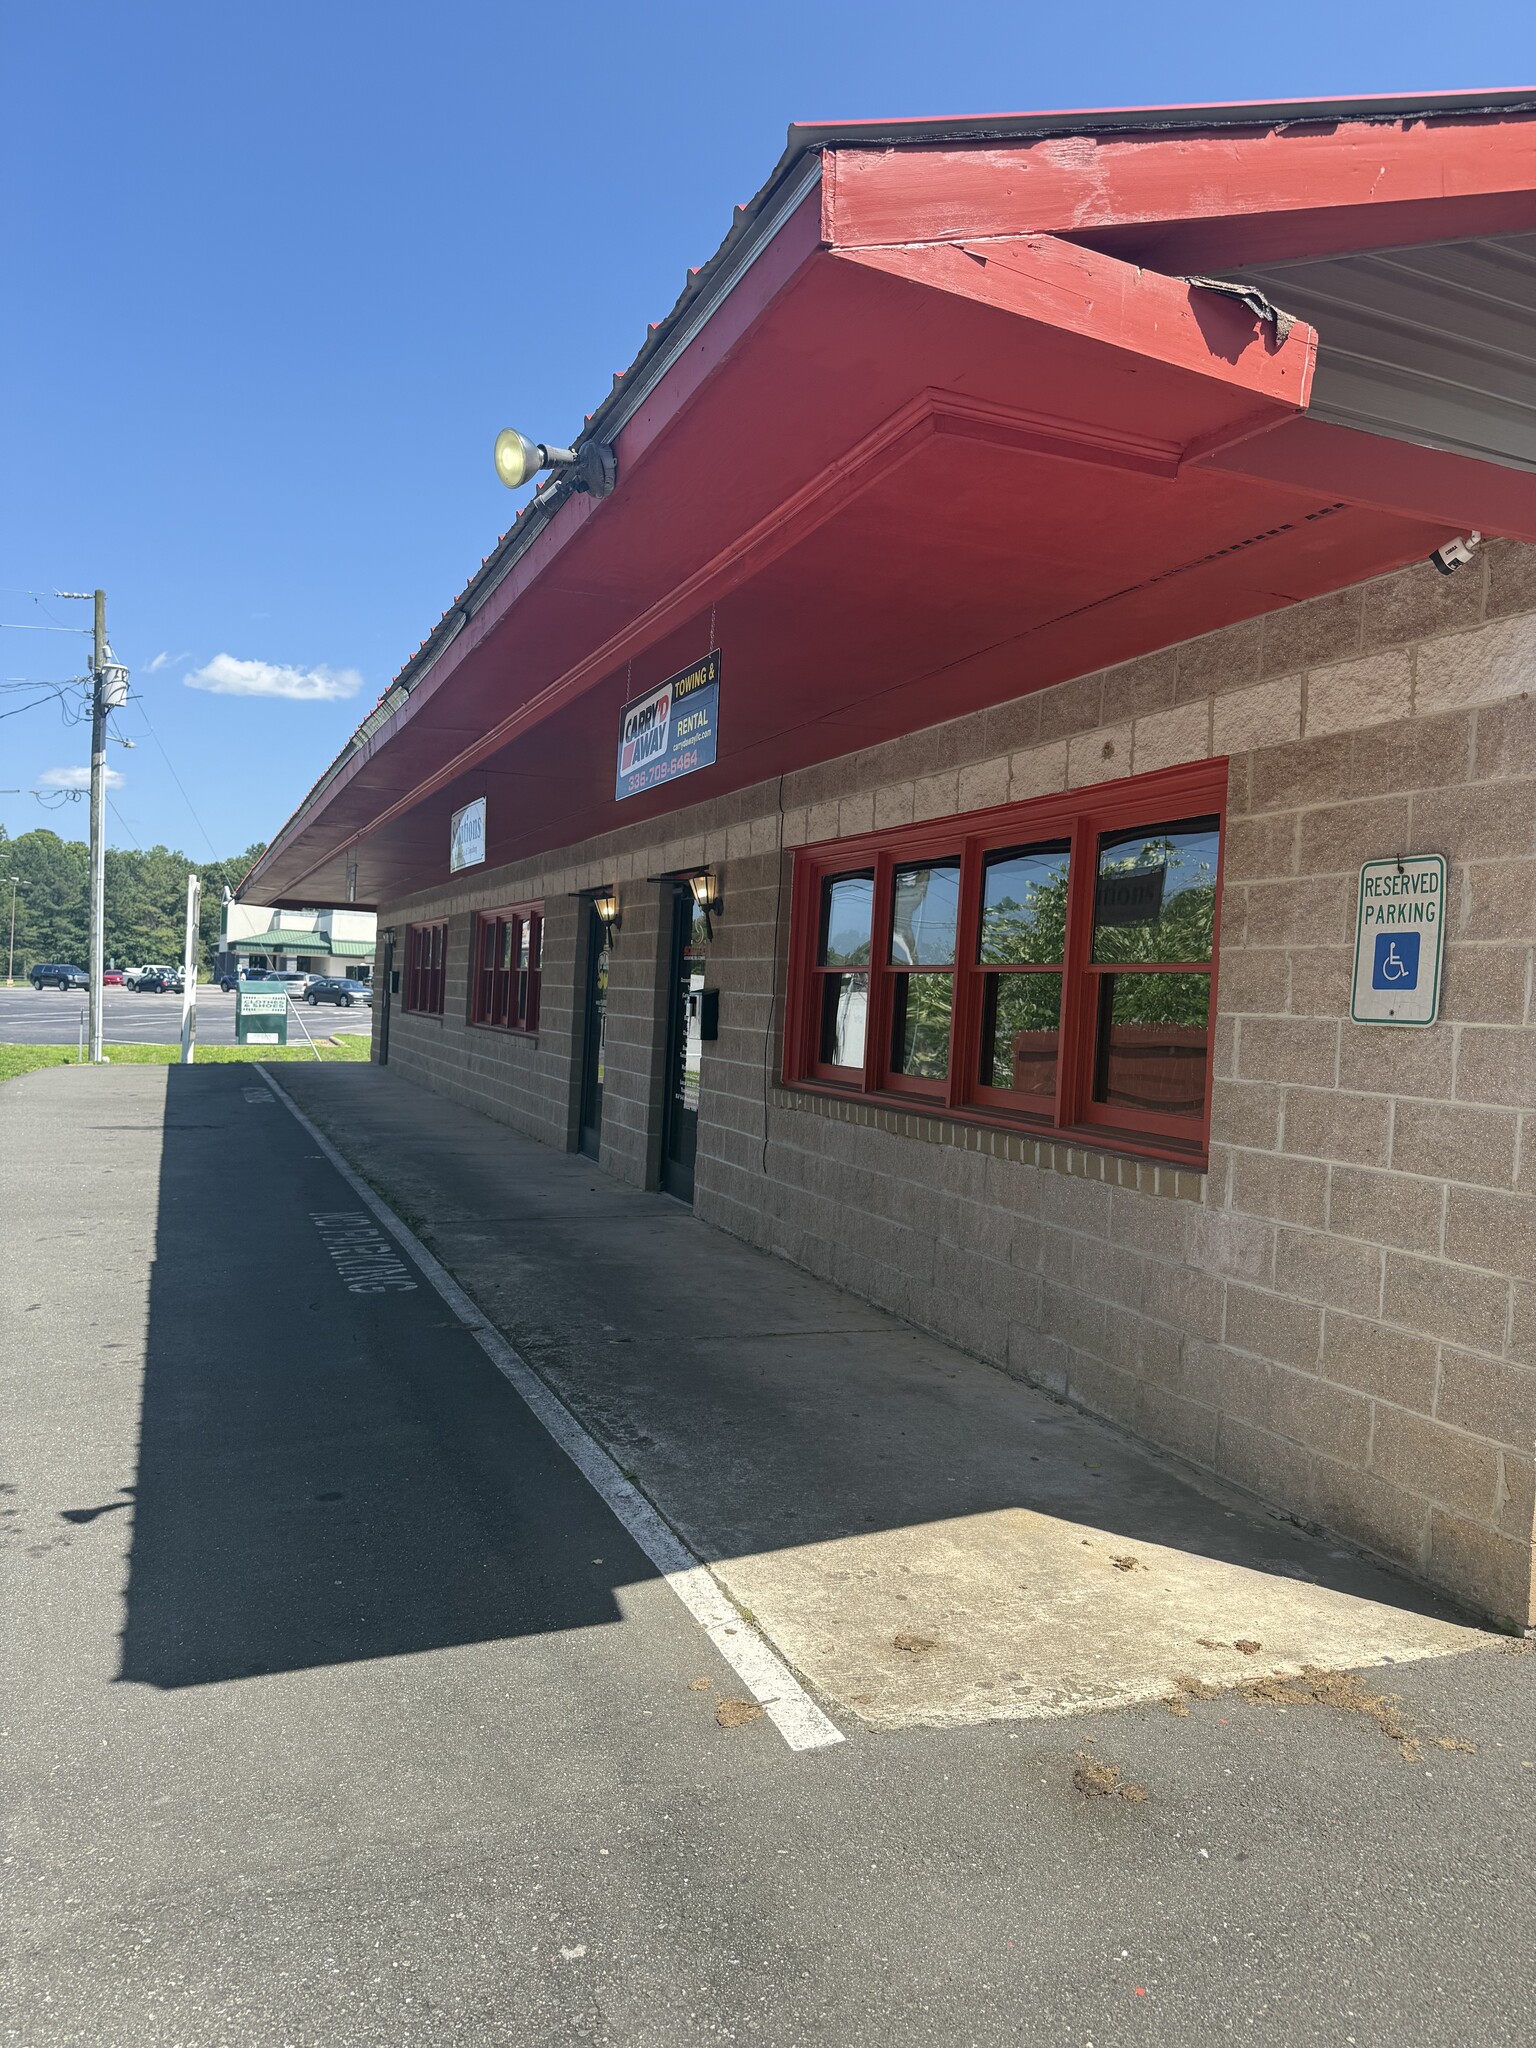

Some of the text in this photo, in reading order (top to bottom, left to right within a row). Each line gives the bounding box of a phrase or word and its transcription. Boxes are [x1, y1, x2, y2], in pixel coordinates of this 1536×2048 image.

[674, 662, 715, 698] TOWING &
[677, 708, 709, 737] RENTAL
[631, 721, 667, 766] AWAY
[1364, 872, 1439, 897] RESERVED
[1364, 901, 1436, 925] PARKING
[308, 1211, 419, 1294] NO PARKING
